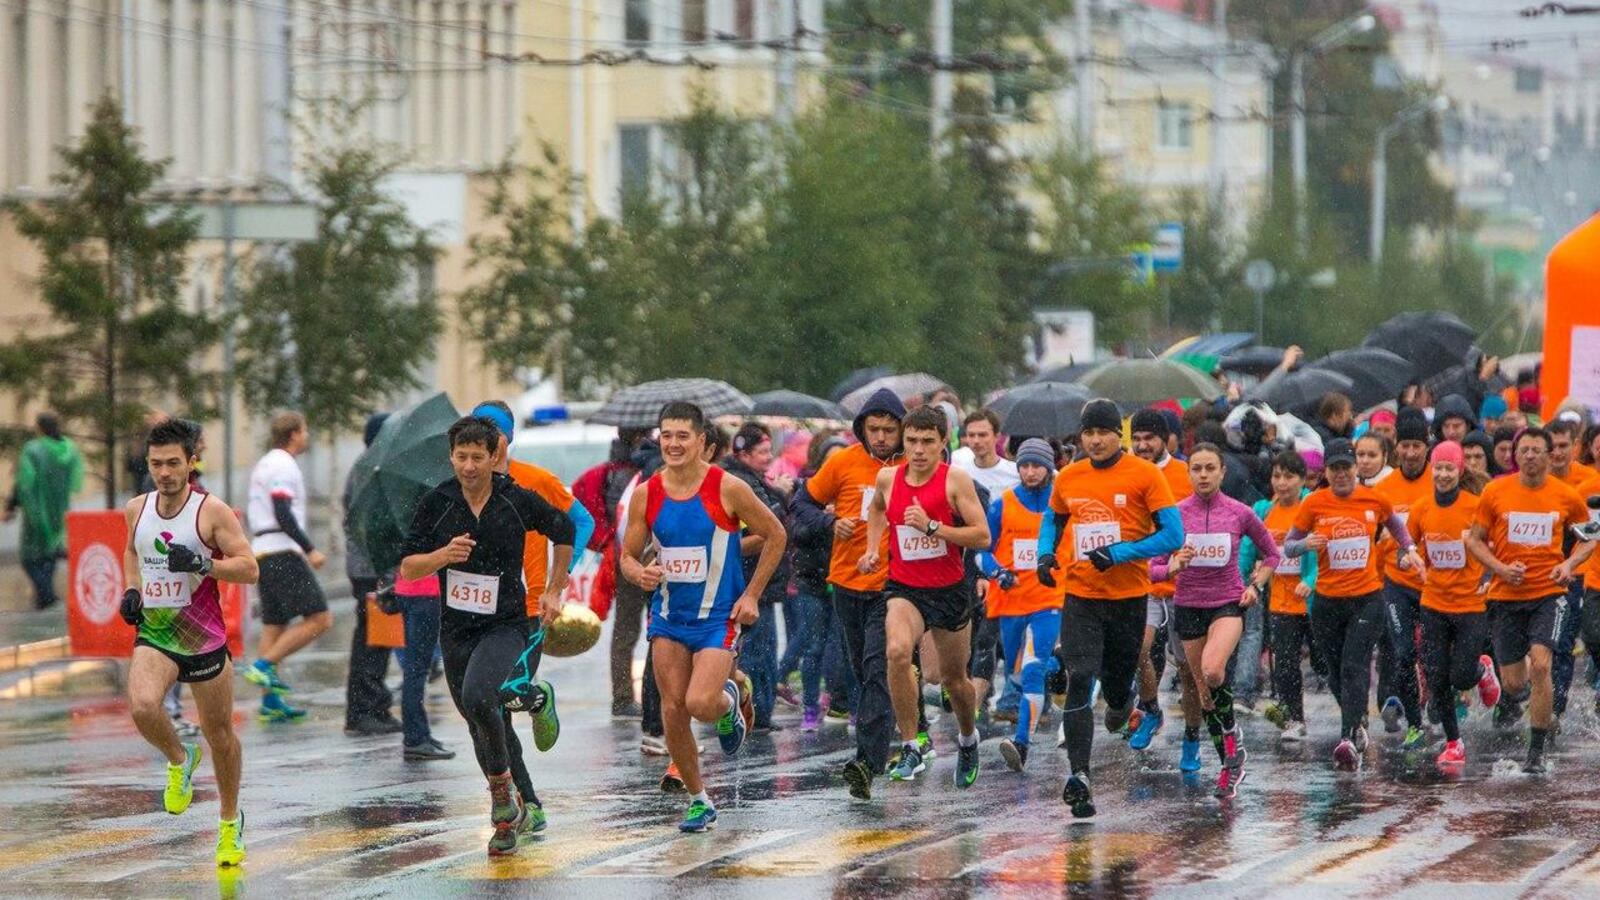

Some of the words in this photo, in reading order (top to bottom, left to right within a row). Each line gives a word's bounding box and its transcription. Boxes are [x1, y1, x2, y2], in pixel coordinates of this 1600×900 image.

[1512, 522, 1546, 537] 4771
[903, 535, 940, 551] 4789
[1018, 549, 1038, 561] 45
[1333, 548, 1366, 562] 4492
[1431, 550, 1462, 561] 4765
[665, 559, 701, 573] 4577
[145, 581, 182, 597] 4317
[451, 584, 492, 604] 4318
